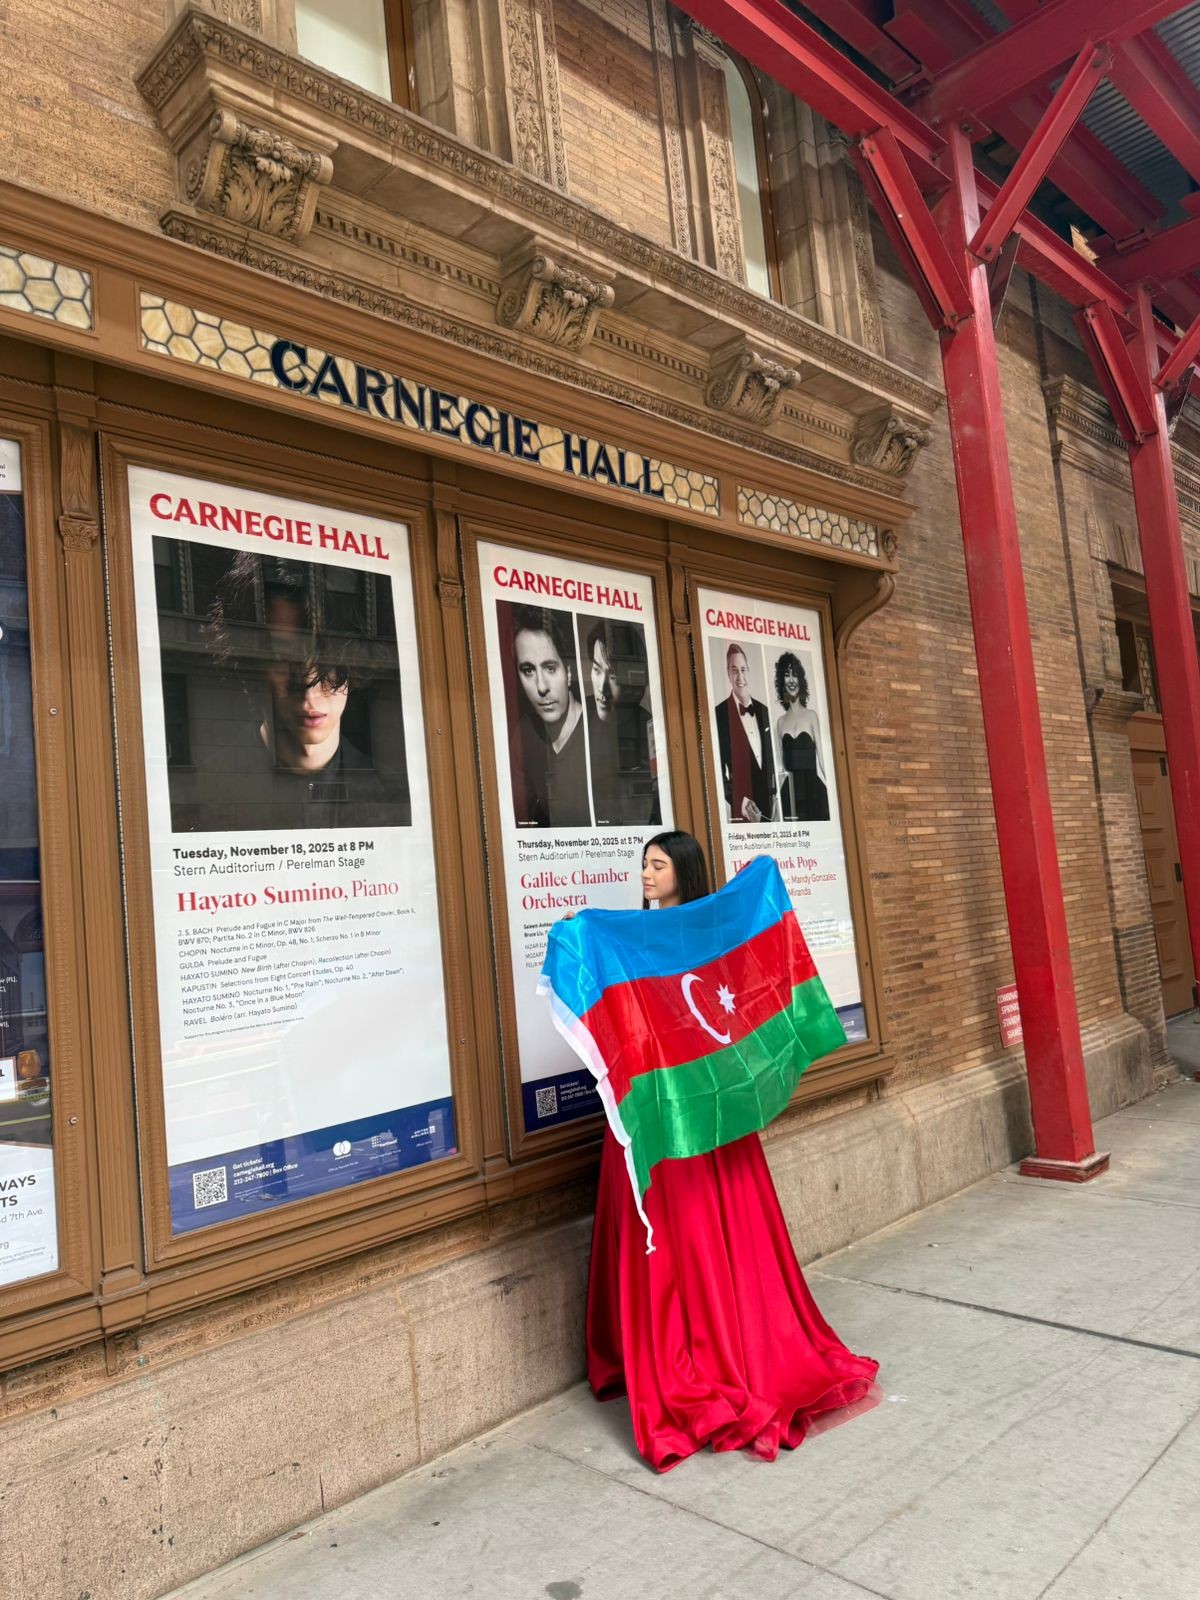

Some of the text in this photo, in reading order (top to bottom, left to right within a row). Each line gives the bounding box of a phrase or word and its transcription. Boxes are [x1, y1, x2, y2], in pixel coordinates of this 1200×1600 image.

[270, 340, 664, 497] CARNEGIE HALL
[150, 493, 390, 560] CARNEGIE HALL
[493, 566, 642, 611] CARNEGIE HALL
[706, 609, 810, 641] CARNEGIE HALL
[517, 840, 553, 849] Thursday,
[555, 838, 589, 847] November
[591, 838, 601, 846] 20,
[603, 837, 619, 846] 2025
[728, 833, 746, 841] Friday,
[172, 841, 374, 860] Tuesday, November 18, 2025 at 8 PM
[518, 853, 538, 862] Stern
[540, 851, 579, 861] Auditorium
[585, 850, 616, 858] Perelman
[618, 849, 634, 858] Stage
[174, 865, 206, 876] Stern
[209, 862, 275, 874] Auditorium
[286, 859, 335, 870] Perelman
[338, 857, 365, 869] Stage
[797, 857, 818, 870] Pops
[521, 868, 629, 889] Galilee Chamber
[792, 875, 811, 884] Mandy
[811, 873, 837, 882] Gonzalez
[177, 879, 399, 915] Hayato Sumino, Piano
[522, 893, 587, 910] Orchestra
[216, 925, 241, 933] Prelude
[179, 948, 207, 957] CHOPIN
[211, 945, 240, 954] Nocturne
[179, 961, 204, 969] GULDA
[180, 972, 209, 981] HAYATO
[211, 968, 238, 977] SUMINO
[181, 983, 217, 993] KAPUSTIN
[220, 979, 253, 988] Selections
[287, 971, 311, 979] Concert
[182, 995, 211, 1005] HAYATO
[213, 991, 240, 1001] SUMINO
[243, 987, 272, 997] Nocturne
[325, 976, 350, 984] Nocturne
[183, 1005, 214, 1014] Nocturne
[184, 1018, 207, 1027] RAVEL
[248, 1008, 271, 1017] Hayato
[272, 1003, 297, 1013] Sumino)
[9, 1212, 24, 1221] 7th
[26, 1208, 44, 1217] Ave.
